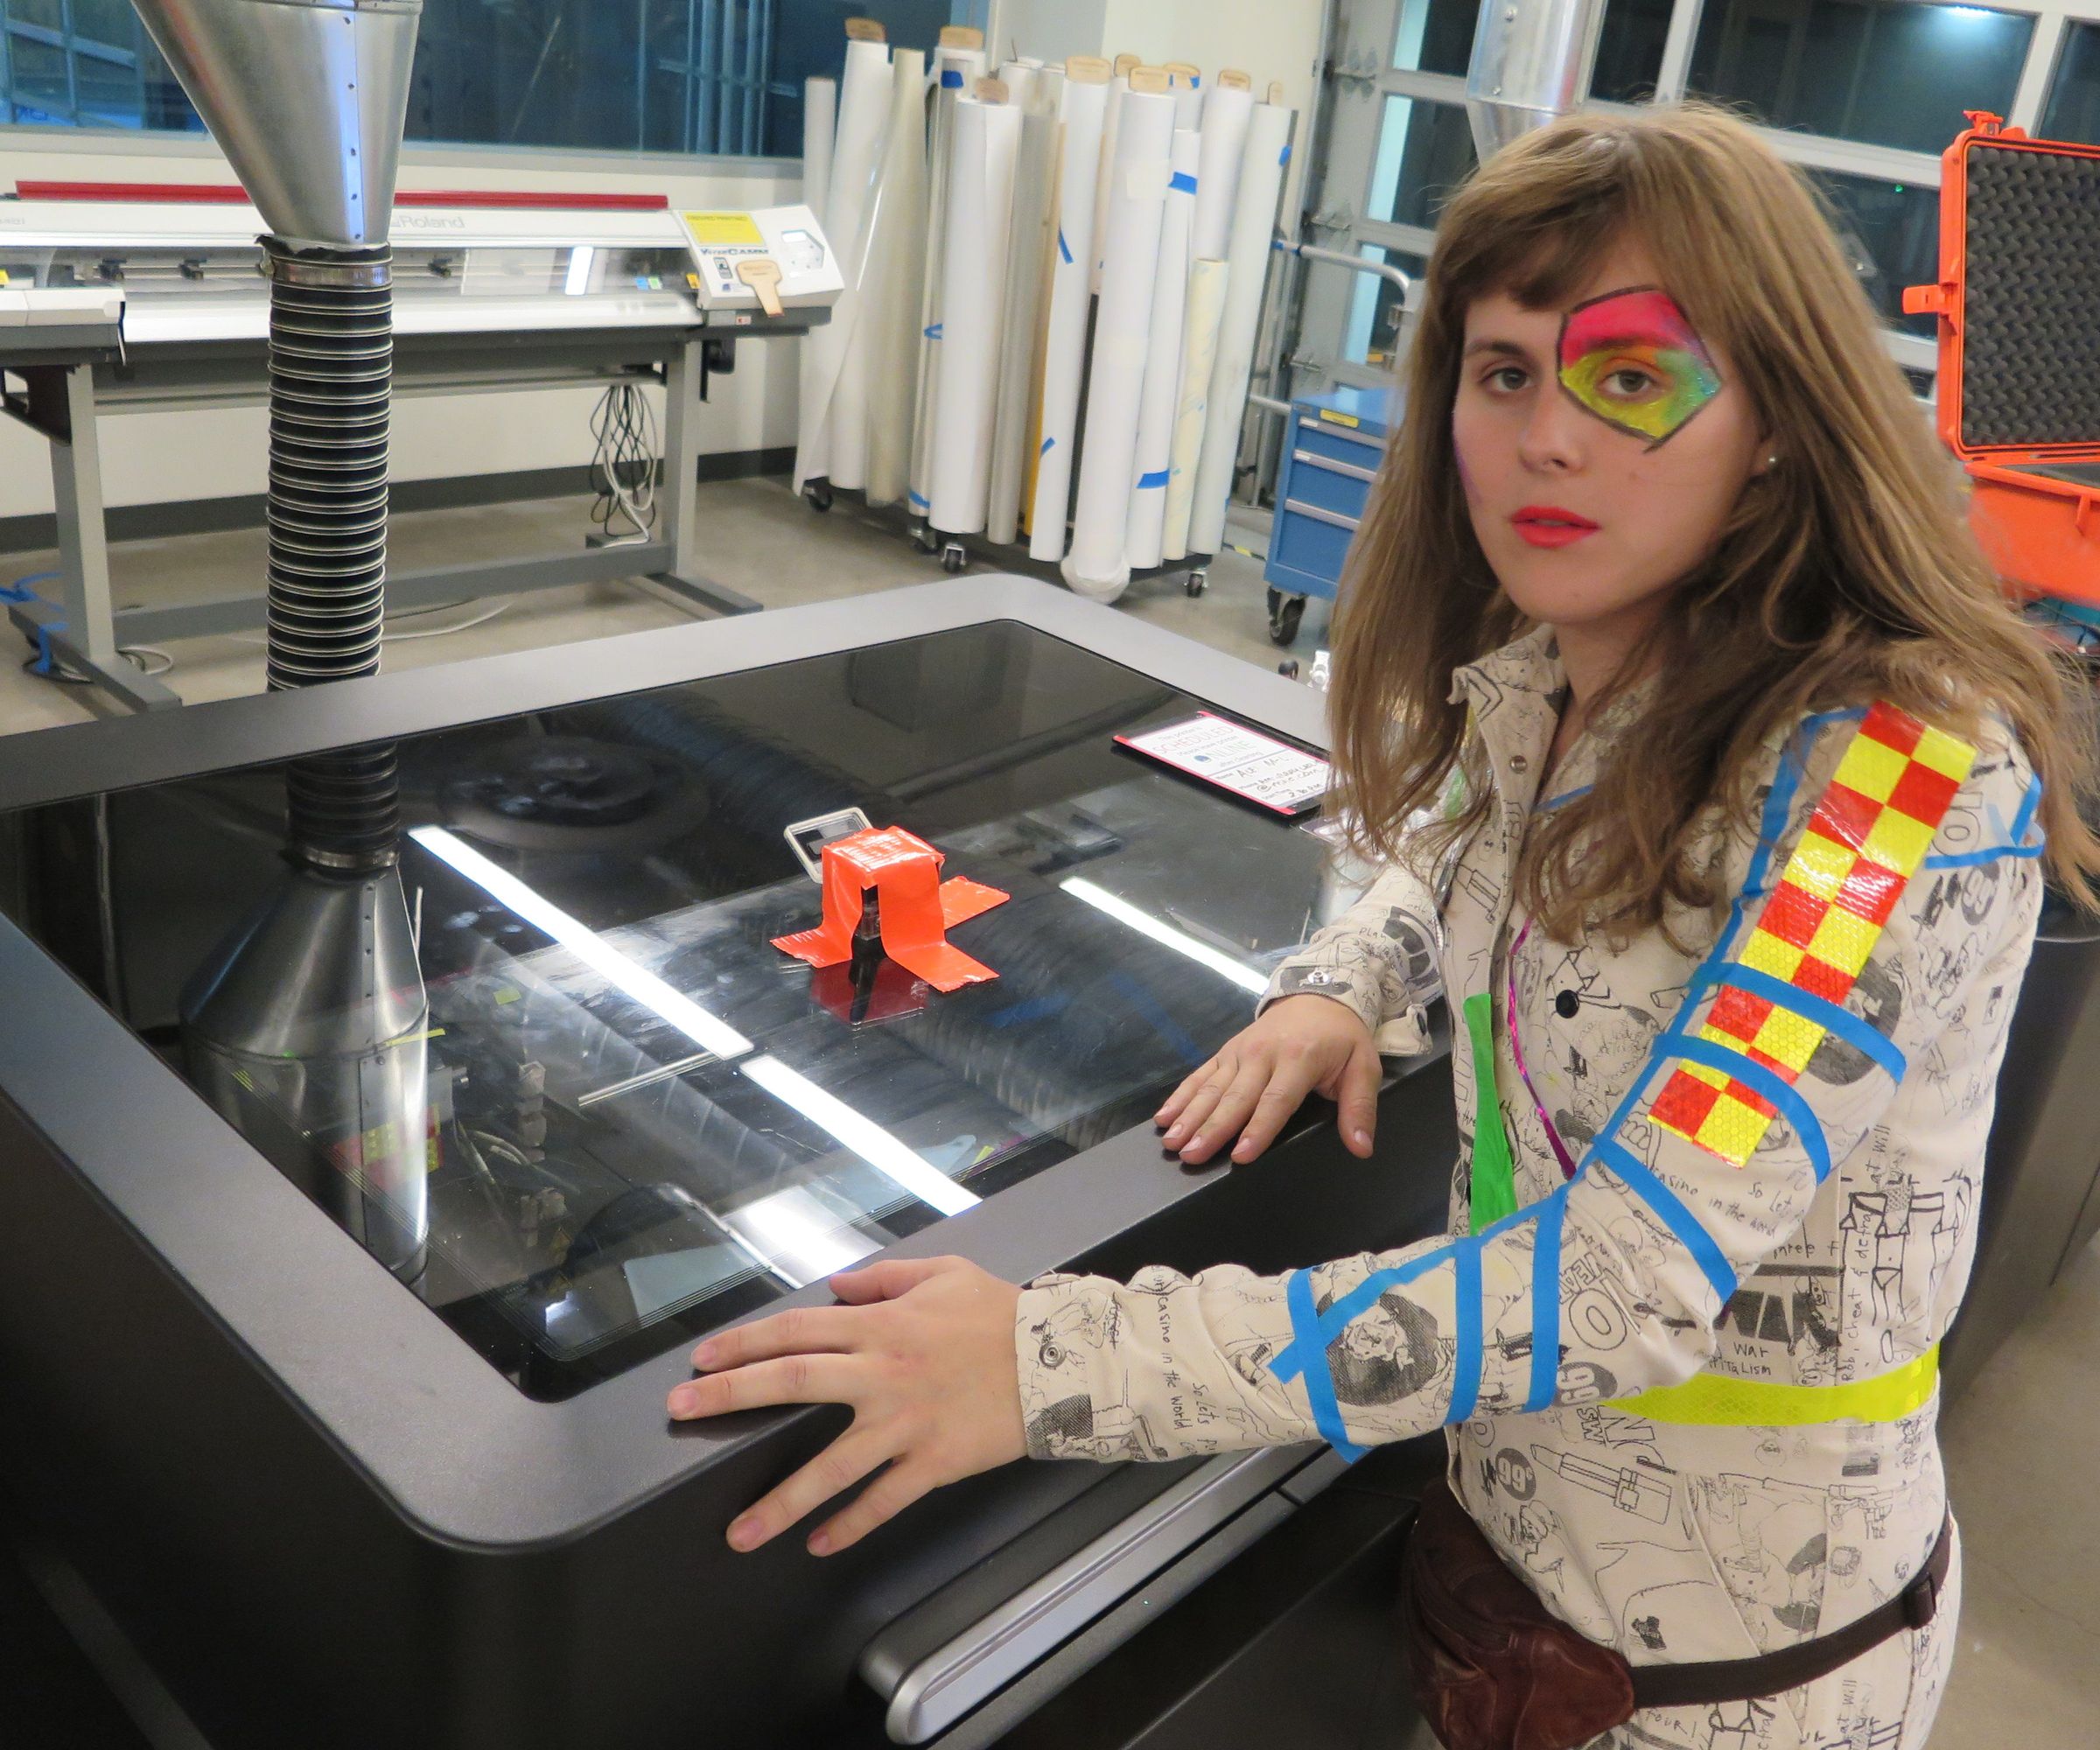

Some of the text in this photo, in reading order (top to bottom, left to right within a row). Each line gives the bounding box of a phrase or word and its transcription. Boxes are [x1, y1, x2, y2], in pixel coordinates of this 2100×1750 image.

[398, 214, 466, 229] Roland
[1654, 1167, 1698, 1195] asino
[1726, 1201, 1746, 1222] the
[1157, 1297, 1172, 1343] casino
[1162, 1352, 1172, 1364] in
[1163, 1370, 1180, 1388] the
